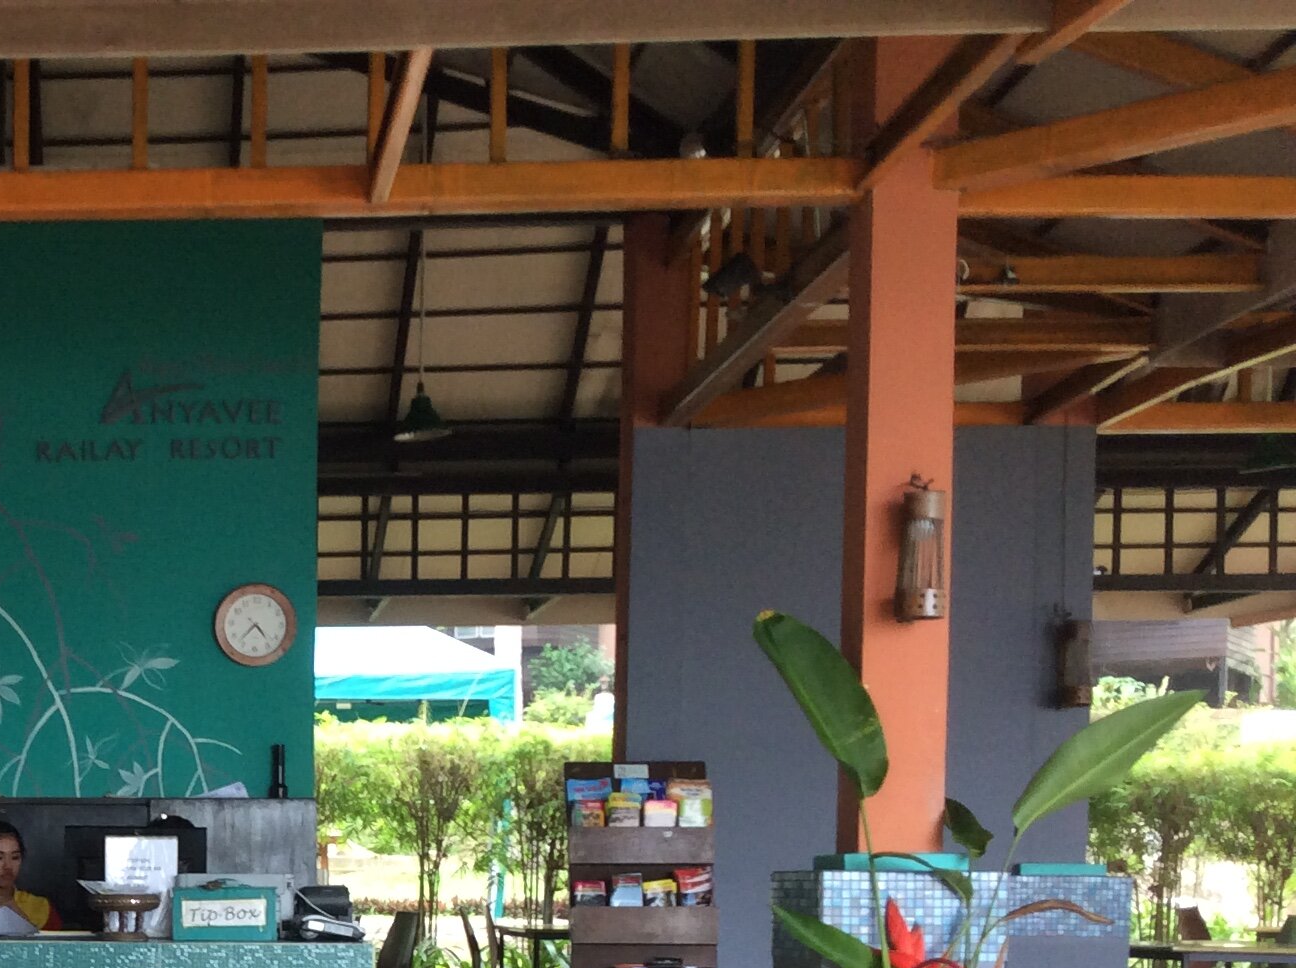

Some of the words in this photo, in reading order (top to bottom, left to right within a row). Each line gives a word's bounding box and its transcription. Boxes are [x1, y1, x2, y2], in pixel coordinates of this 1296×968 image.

[99, 368, 283, 425] ANYAVEE
[35, 438, 142, 463] RAILAY
[170, 436, 282, 460] RESORT
